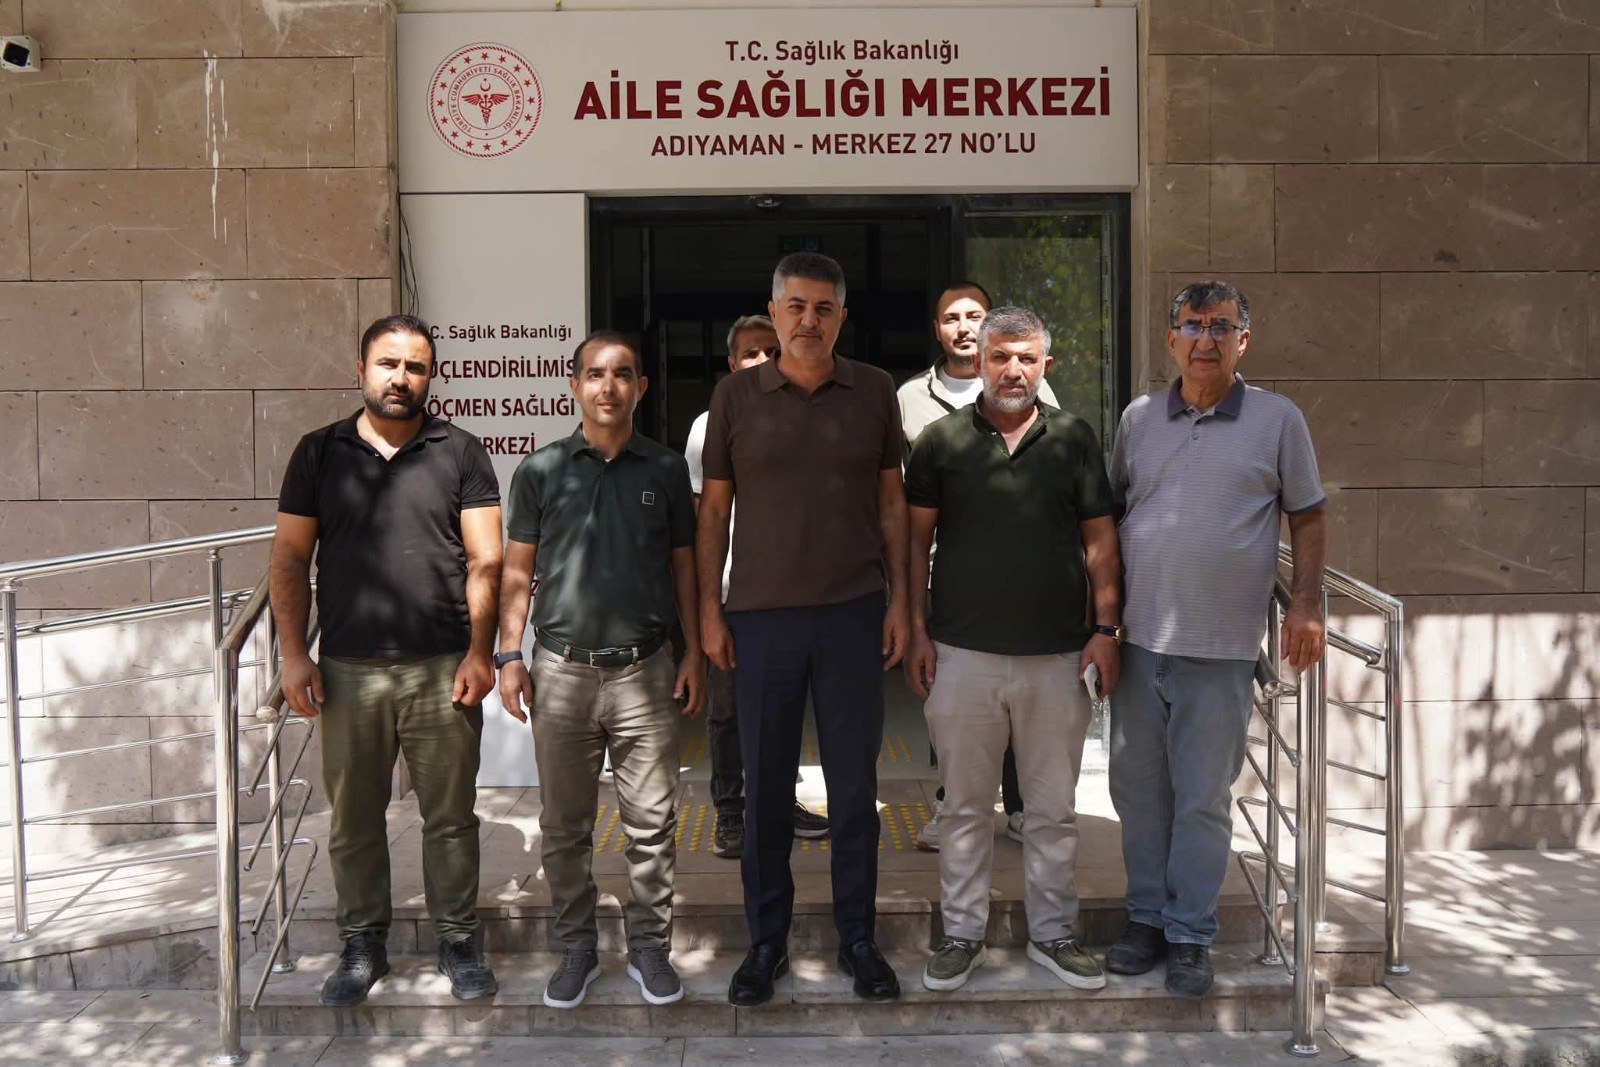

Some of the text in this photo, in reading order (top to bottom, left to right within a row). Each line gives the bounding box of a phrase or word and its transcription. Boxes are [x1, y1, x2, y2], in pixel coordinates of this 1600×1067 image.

[725, 39, 959, 66] T.C. Sağlık Bakanlığı
[494, 68, 518, 89] SAĞLIK
[574, 66, 1111, 120] AİLE SAĞLIĞI MERKEZİ
[650, 134, 785, 157] ADIYAMAN
[812, 132, 917, 155] MERKEZ
[924, 132, 953, 154] 27
[960, 131, 1036, 154] NO'LU
[430, 324, 572, 342] C. Sağlık Bakanlığı
[430, 355, 575, 384] ÇLENDİRİLİMİ
[427, 393, 575, 421] ÖÇMEN SAĞLIĞI
[479, 432, 535, 455] RKEZİ
